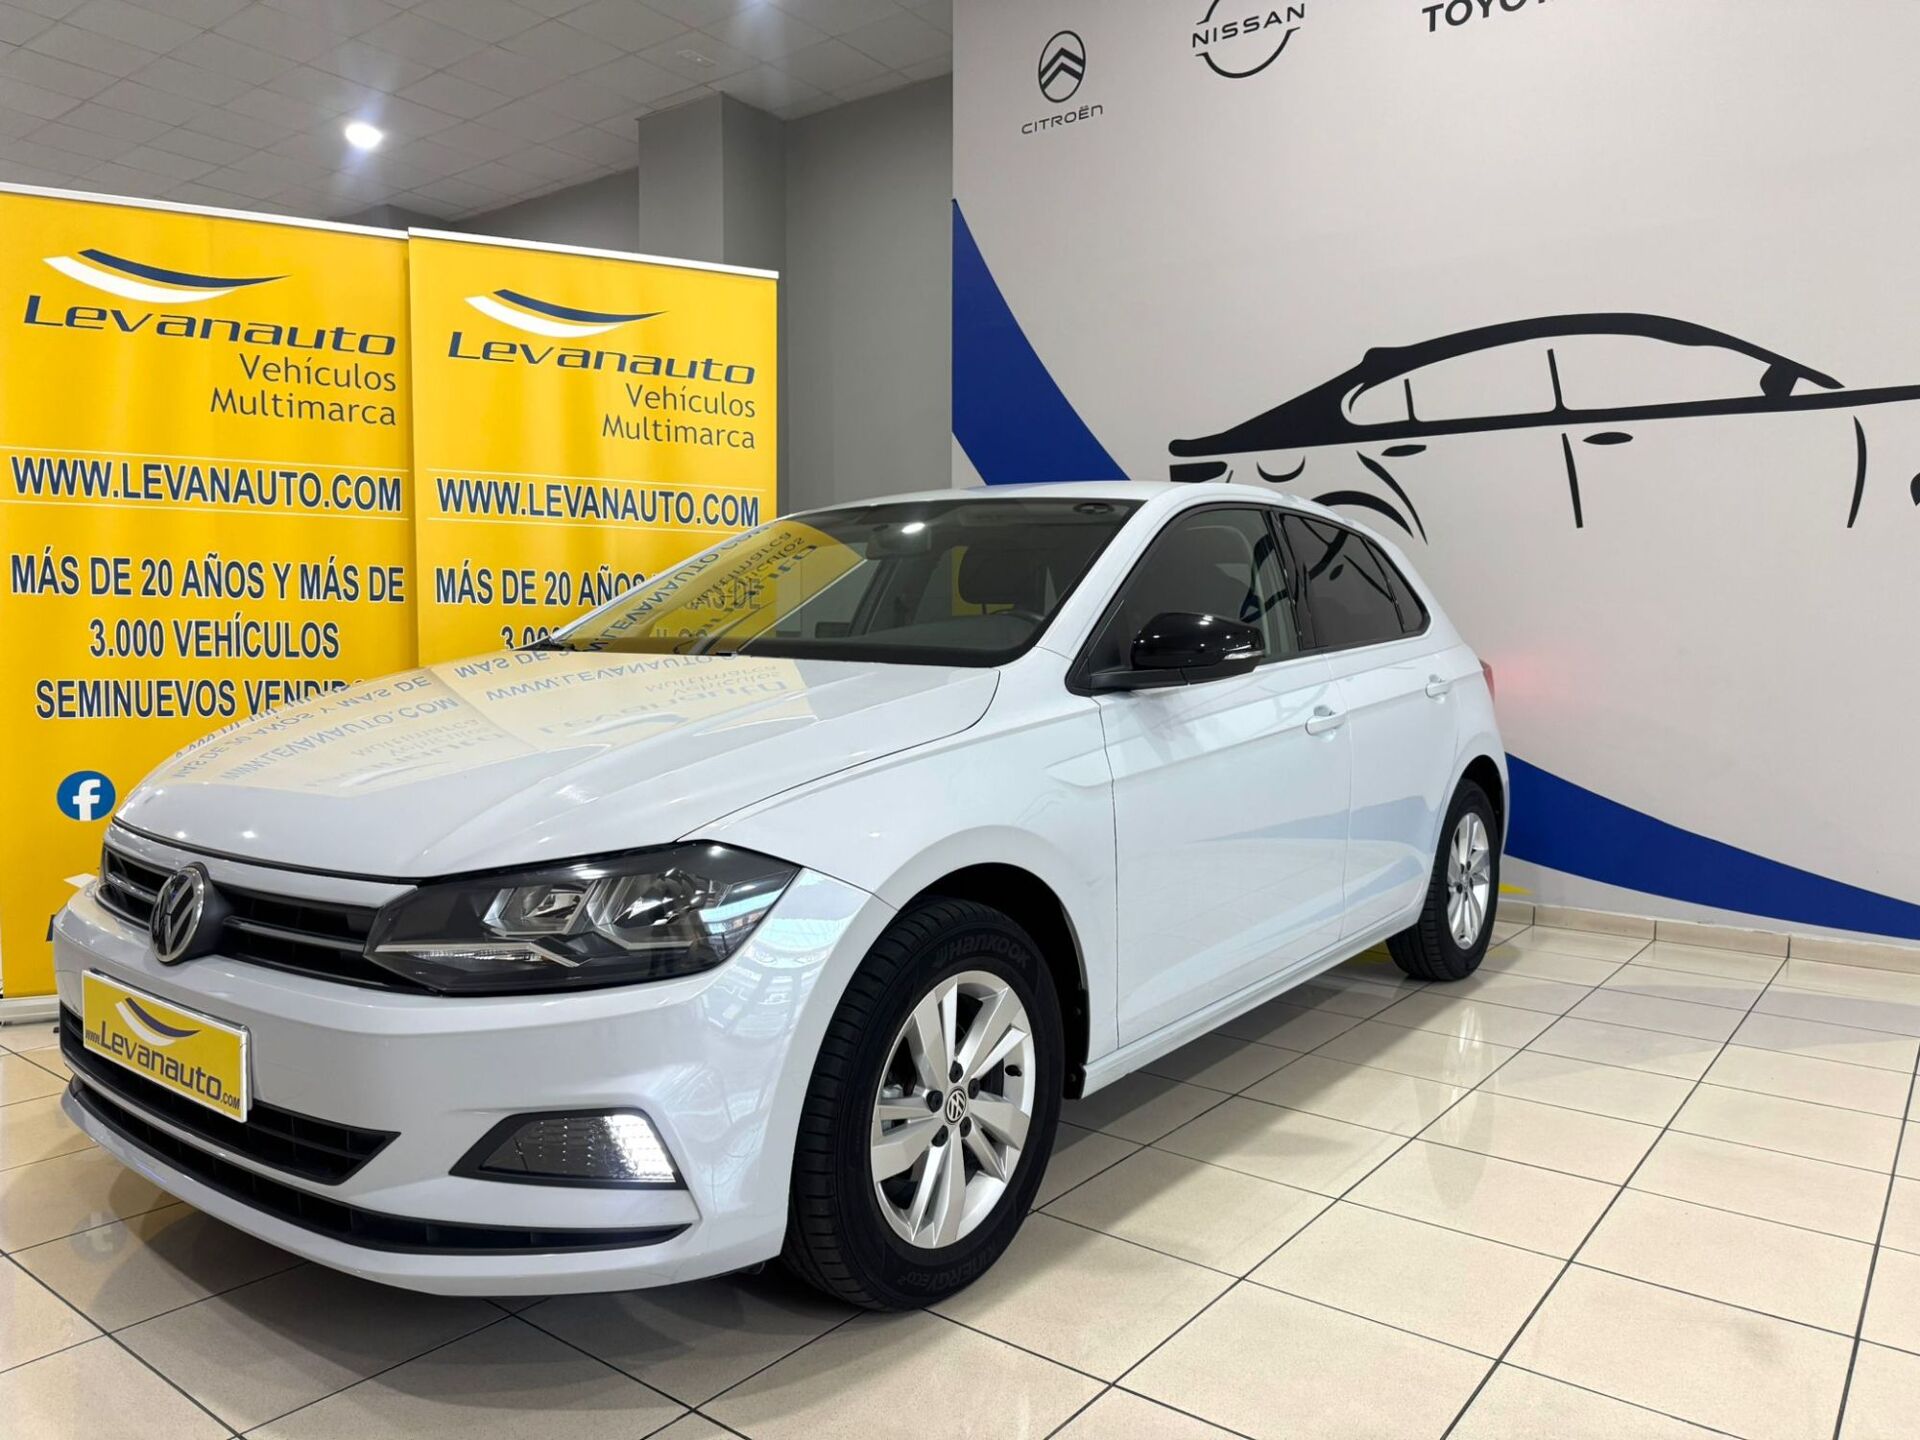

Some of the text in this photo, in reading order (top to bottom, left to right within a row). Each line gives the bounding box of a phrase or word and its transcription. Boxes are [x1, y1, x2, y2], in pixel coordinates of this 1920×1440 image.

[1192, 3, 1305, 48] NISSAN
[1021, 105, 1104, 135] CITROËN
[24, 294, 397, 357] Levanauto
[239, 353, 397, 392] Vehículos
[448, 331, 756, 386] Levanauto
[210, 387, 397, 426] Multimarca
[625, 383, 756, 418] Vehículos
[602, 414, 756, 450] Multimarca
[11, 456, 402, 512] WWW.LEVANAUTO.COM
[436, 477, 759, 527] WWW.LEVANAUTO.COM
[11, 546, 405, 602] MÁS DE 20 AÑOS Y MÁS DE
[435, 560, 494, 605] MÁS
[502, 569, 537, 605] DE
[544, 570, 571, 606] 20
[89, 612, 340, 659] 3.000 VEHÍCULOS
[36, 679, 236, 718] SEMINUEVOS
